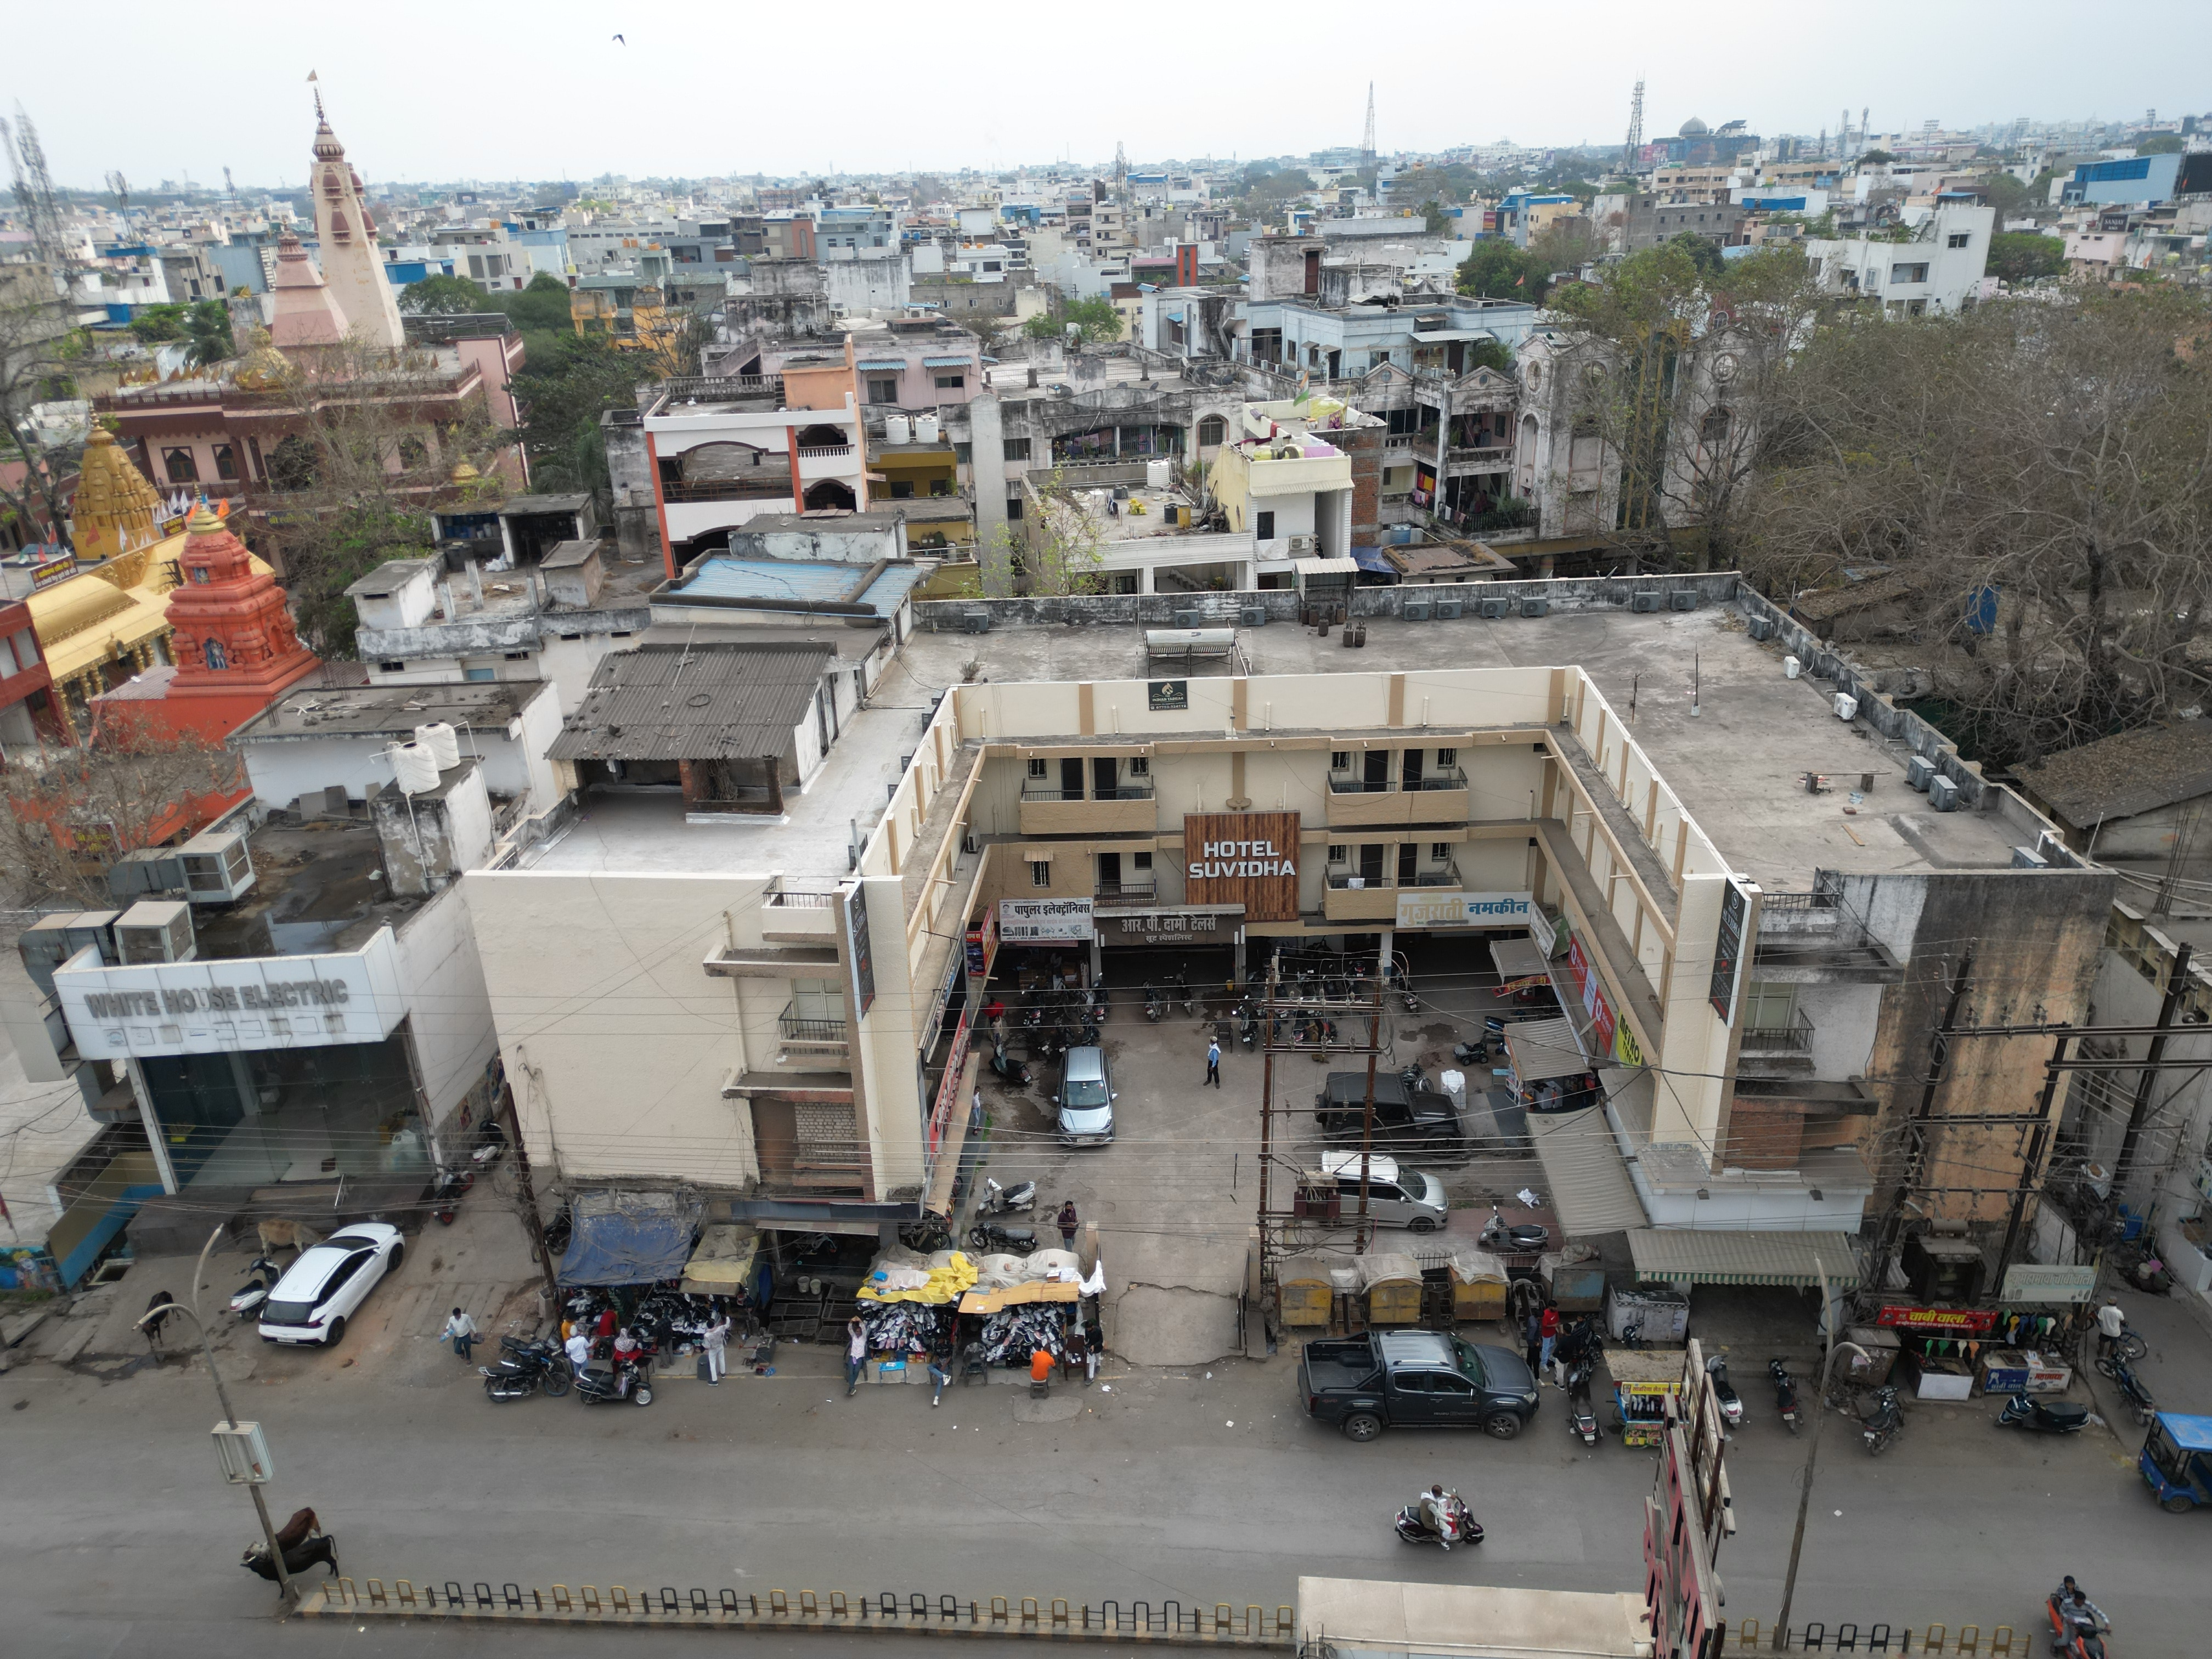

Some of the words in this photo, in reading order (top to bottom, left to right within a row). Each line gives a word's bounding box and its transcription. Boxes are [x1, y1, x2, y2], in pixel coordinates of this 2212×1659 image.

[1204, 841, 1279, 857] HOTEL
[1189, 860, 1296, 878] SUVIDHA
[1014, 905, 1041, 918] पापुलर
[1042, 901, 1091, 916] इलेक्ट्रॉनिक्स
[1400, 898, 1466, 927] गुजराती
[1468, 898, 1530, 915] नमकीन
[1121, 918, 1146, 933] आर.
[1147, 915, 1161, 932] पी.
[1163, 915, 1187, 932] दामो
[1190, 913, 1217, 932] टेलर्स
[1722, 908, 1740, 937] SUVIDHA
[1145, 934, 1158, 943] सूट
[84, 991, 160, 1019] WHITE
[161, 986, 239, 1014] HOUSE
[240, 979, 349, 1009] ELECTRIC
[1619, 1014, 1640, 1063] METRO
[1909, 1310, 1937, 1323] चाबी
[1937, 1313, 1967, 1324] वाला
[2035, 1373, 2065, 1381] महामाया
